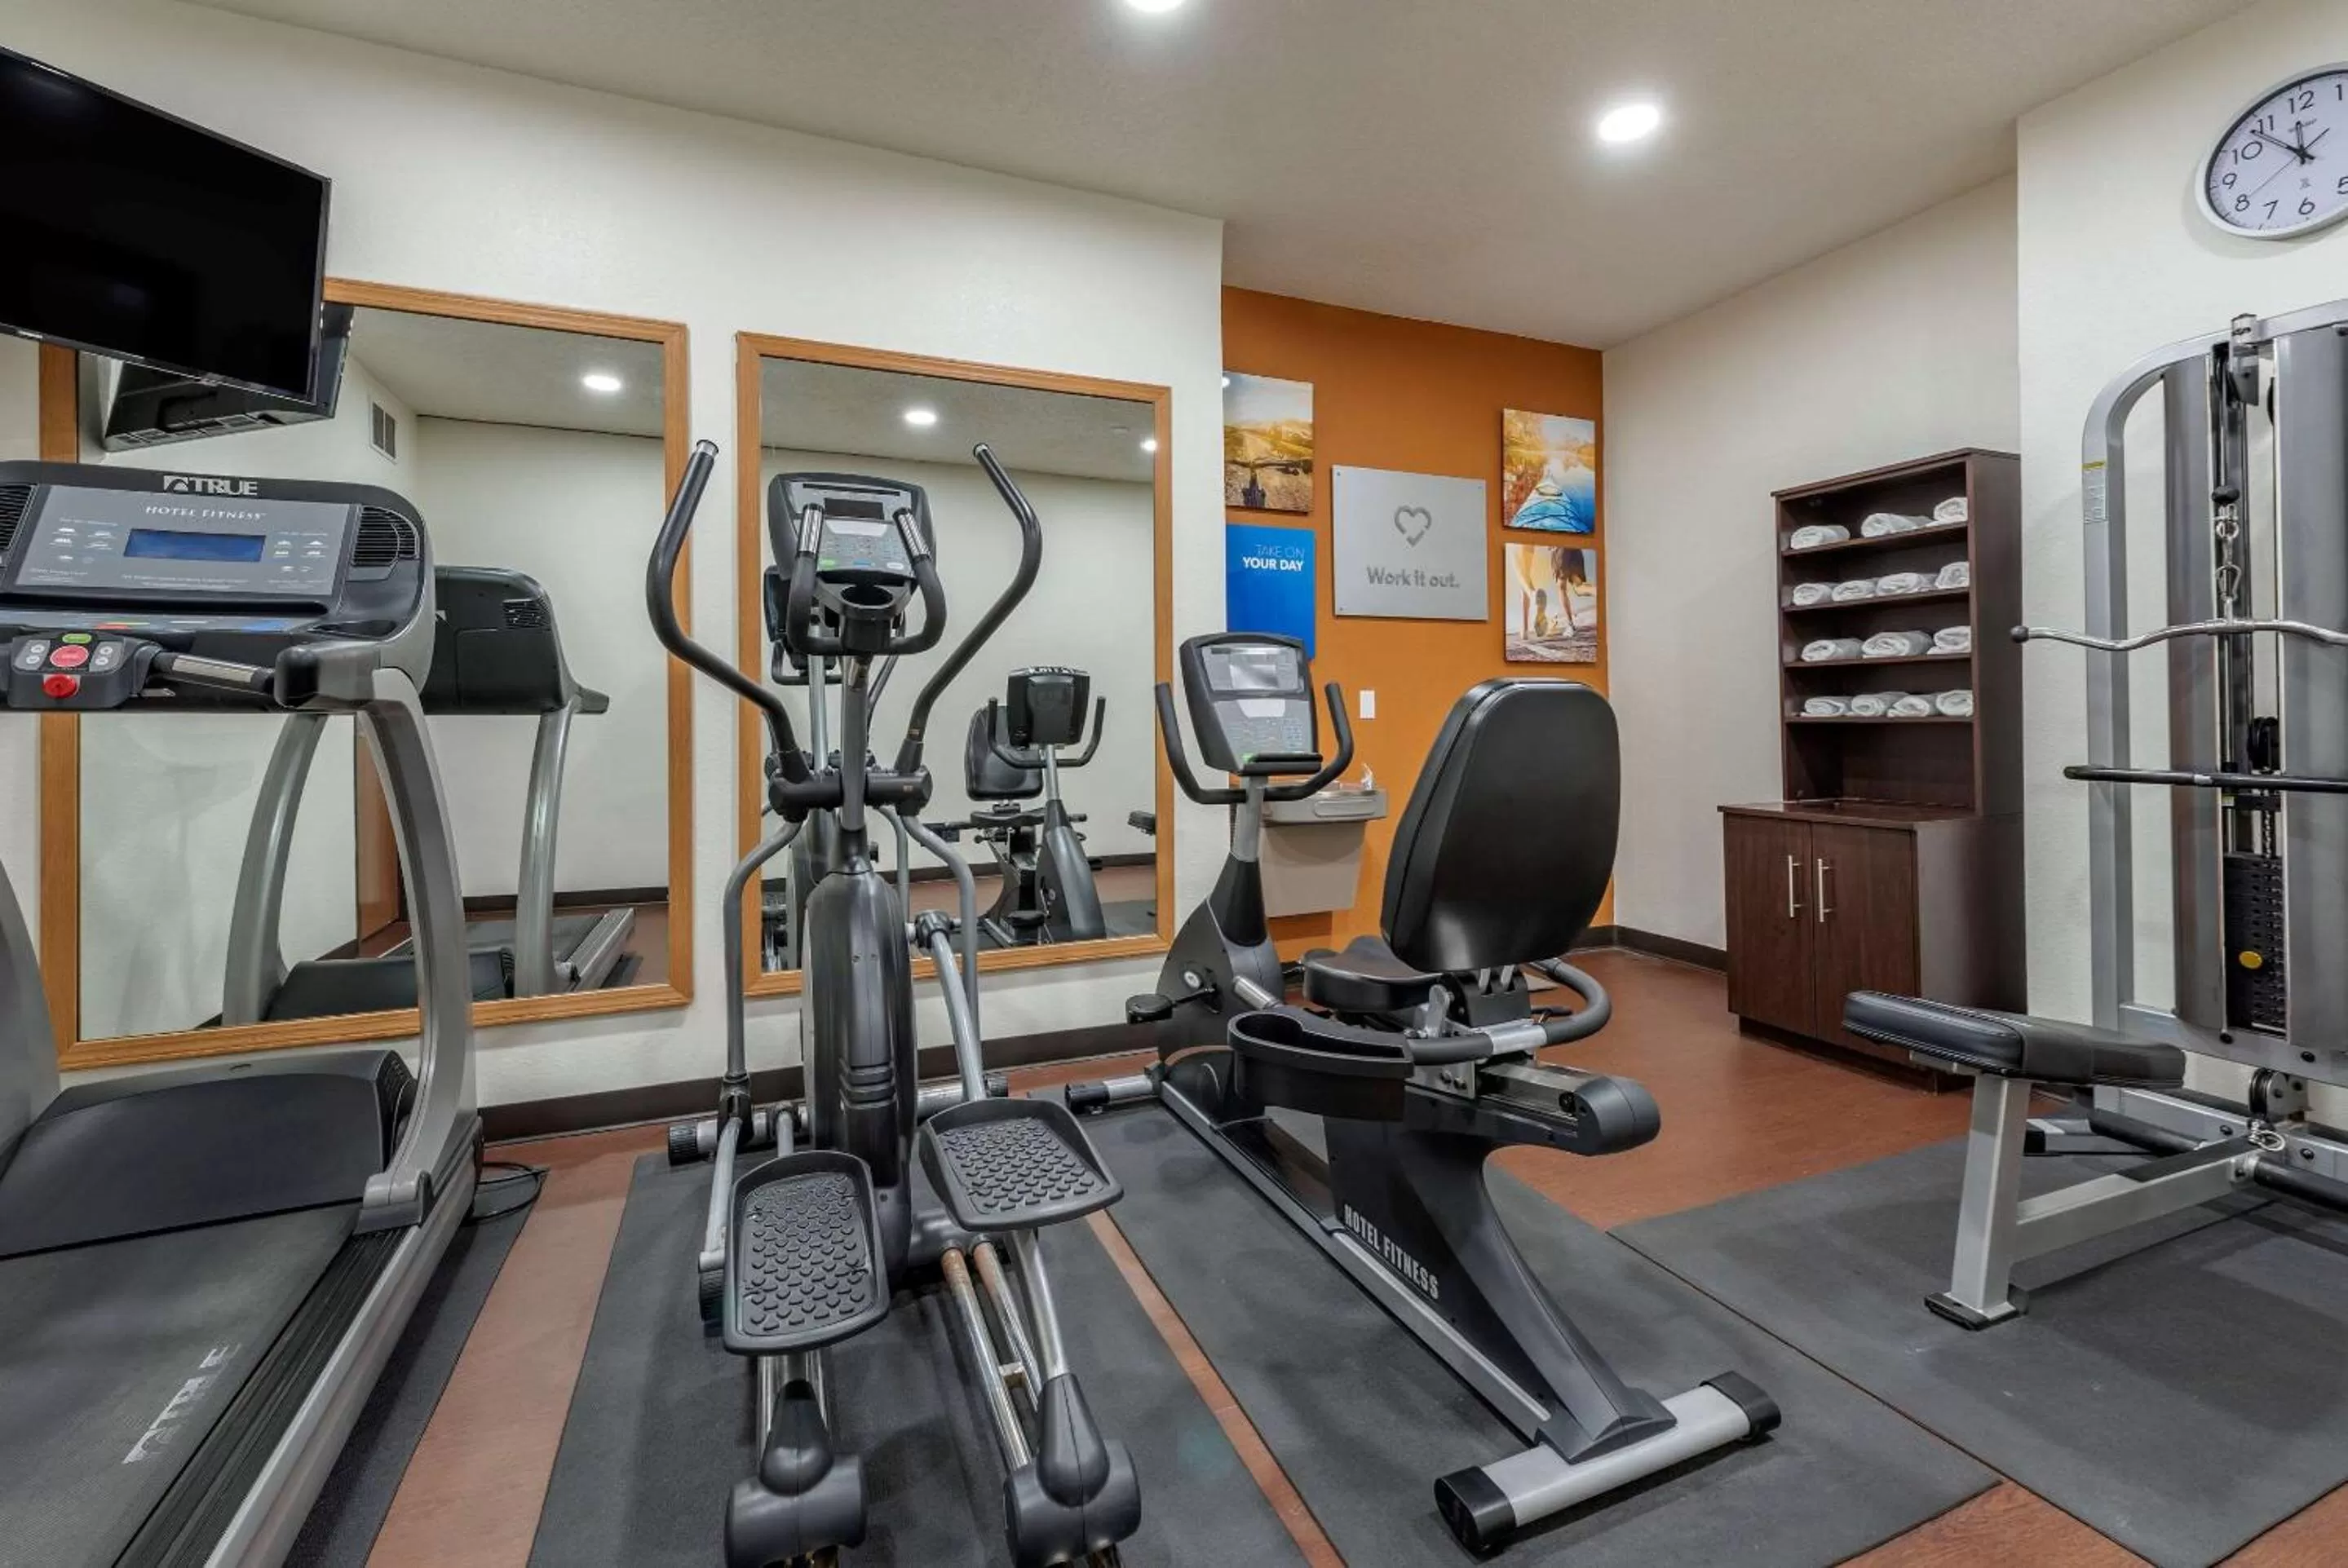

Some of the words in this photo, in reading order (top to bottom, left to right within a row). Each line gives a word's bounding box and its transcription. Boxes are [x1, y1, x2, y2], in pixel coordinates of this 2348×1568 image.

[2288, 90, 2315, 114] 12
[2336, 84, 2343, 101] 1
[2257, 114, 2274, 135] 11
[2231, 140, 2263, 165] 10
[2222, 173, 2237, 189] 9
[2337, 176, 2348, 195] 5
[2235, 194, 2249, 211] 8
[2262, 199, 2279, 220] 7
[2297, 197, 2315, 215] 6
[188, 476, 259, 496] TRUE
[145, 506, 197, 517] HOTEL
[1255, 544, 1283, 558] TAKE
[1285, 546, 1305, 559] ON
[1242, 556, 1277, 570] YOUR
[1280, 559, 1304, 572] DAY
[1366, 567, 1411, 587] Work
[1413, 569, 1426, 587] it
[1429, 572, 1460, 588] out.
[1344, 1204, 1380, 1251] HOTEL
[1383, 1235, 1439, 1299] FITNESS
